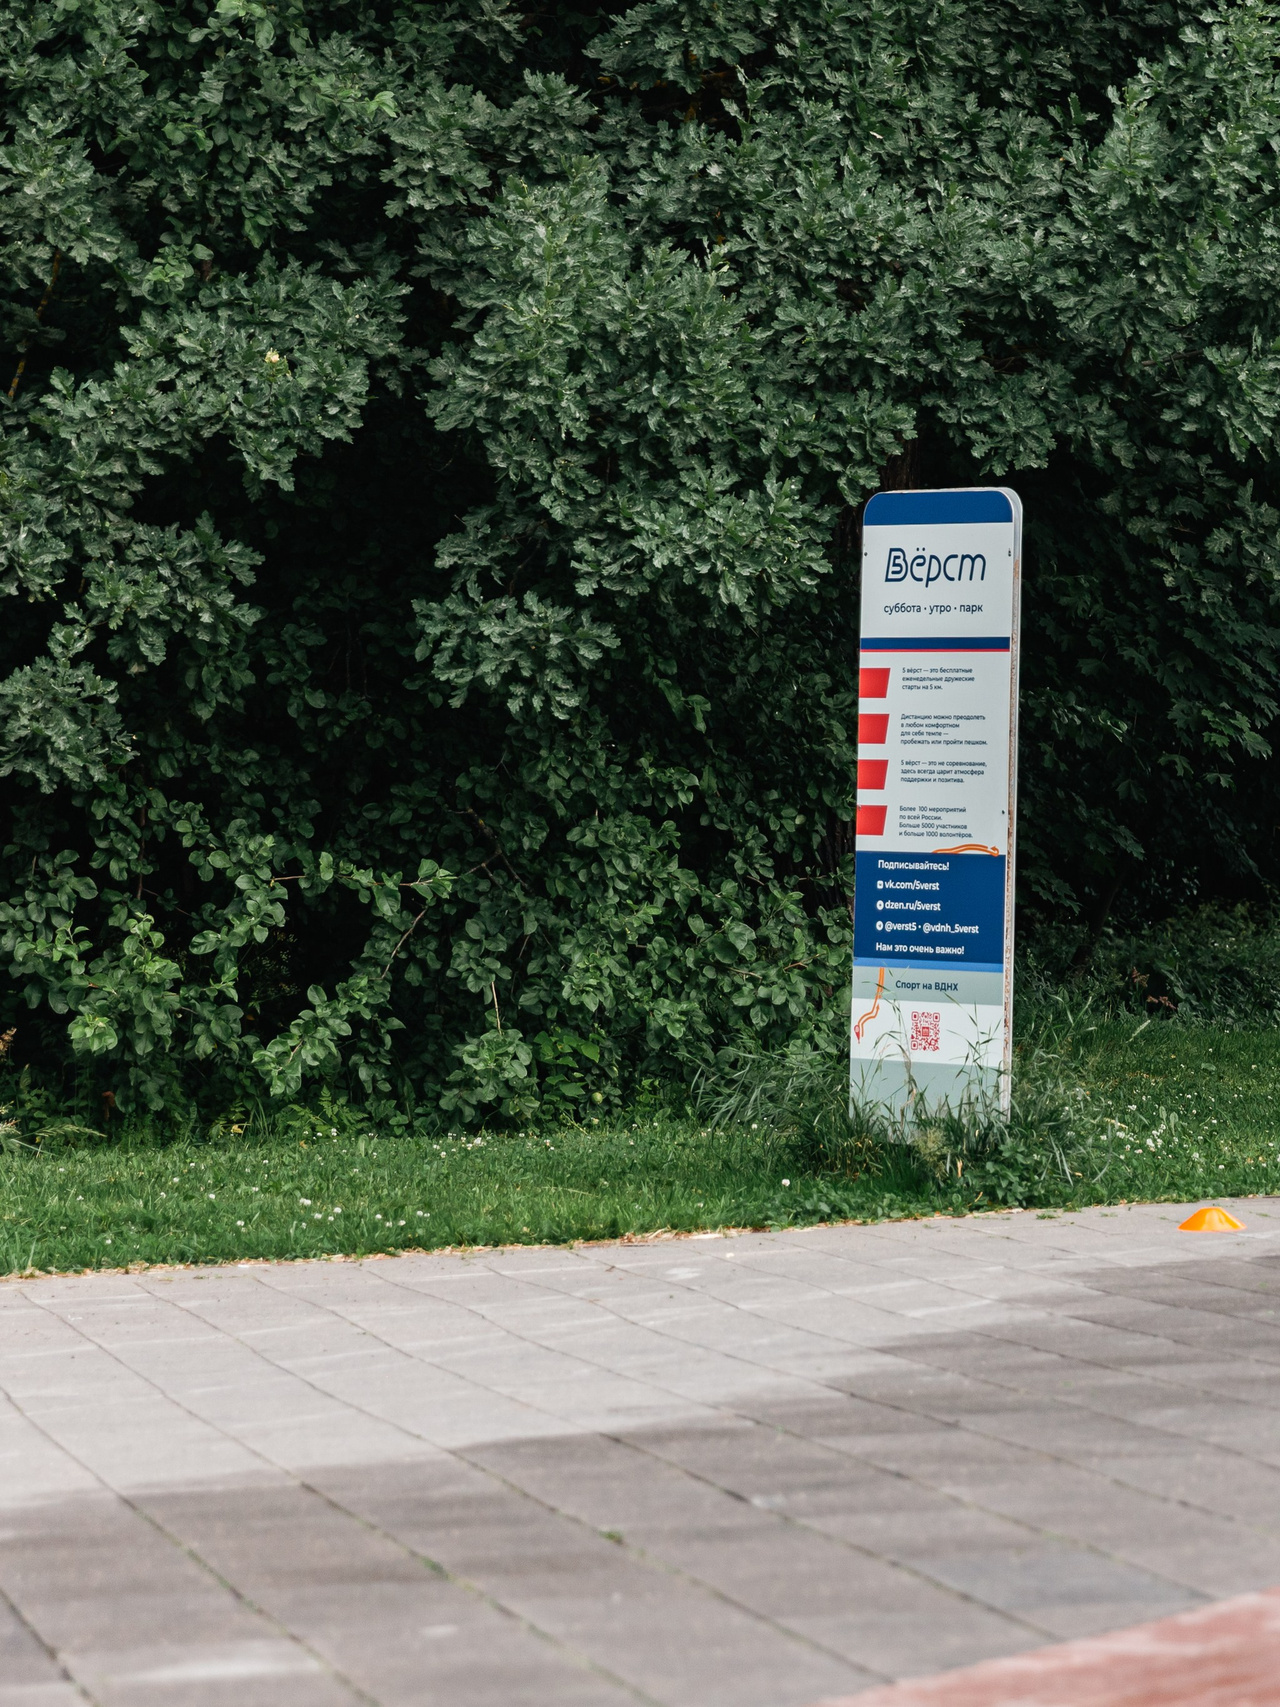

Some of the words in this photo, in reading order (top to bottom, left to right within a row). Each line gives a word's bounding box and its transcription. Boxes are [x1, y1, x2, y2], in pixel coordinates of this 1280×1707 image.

[884, 603, 921, 615] суббота
[929, 604, 951, 614] утро
[960, 604, 983, 613] парк
[878, 860, 949, 870] Подписывайтесь!
[885, 880, 940, 890] vk.com/5verst
[885, 900, 941, 911] dzen.ru/5verst
[885, 922, 916, 932] @verst5
[923, 923, 979, 934] @vdnh_5verst
[876, 943, 893, 951] Нам
[936, 946, 964, 954] важно!
[896, 980, 920, 990] Спорт
[935, 982, 958, 991] ВДНХ
